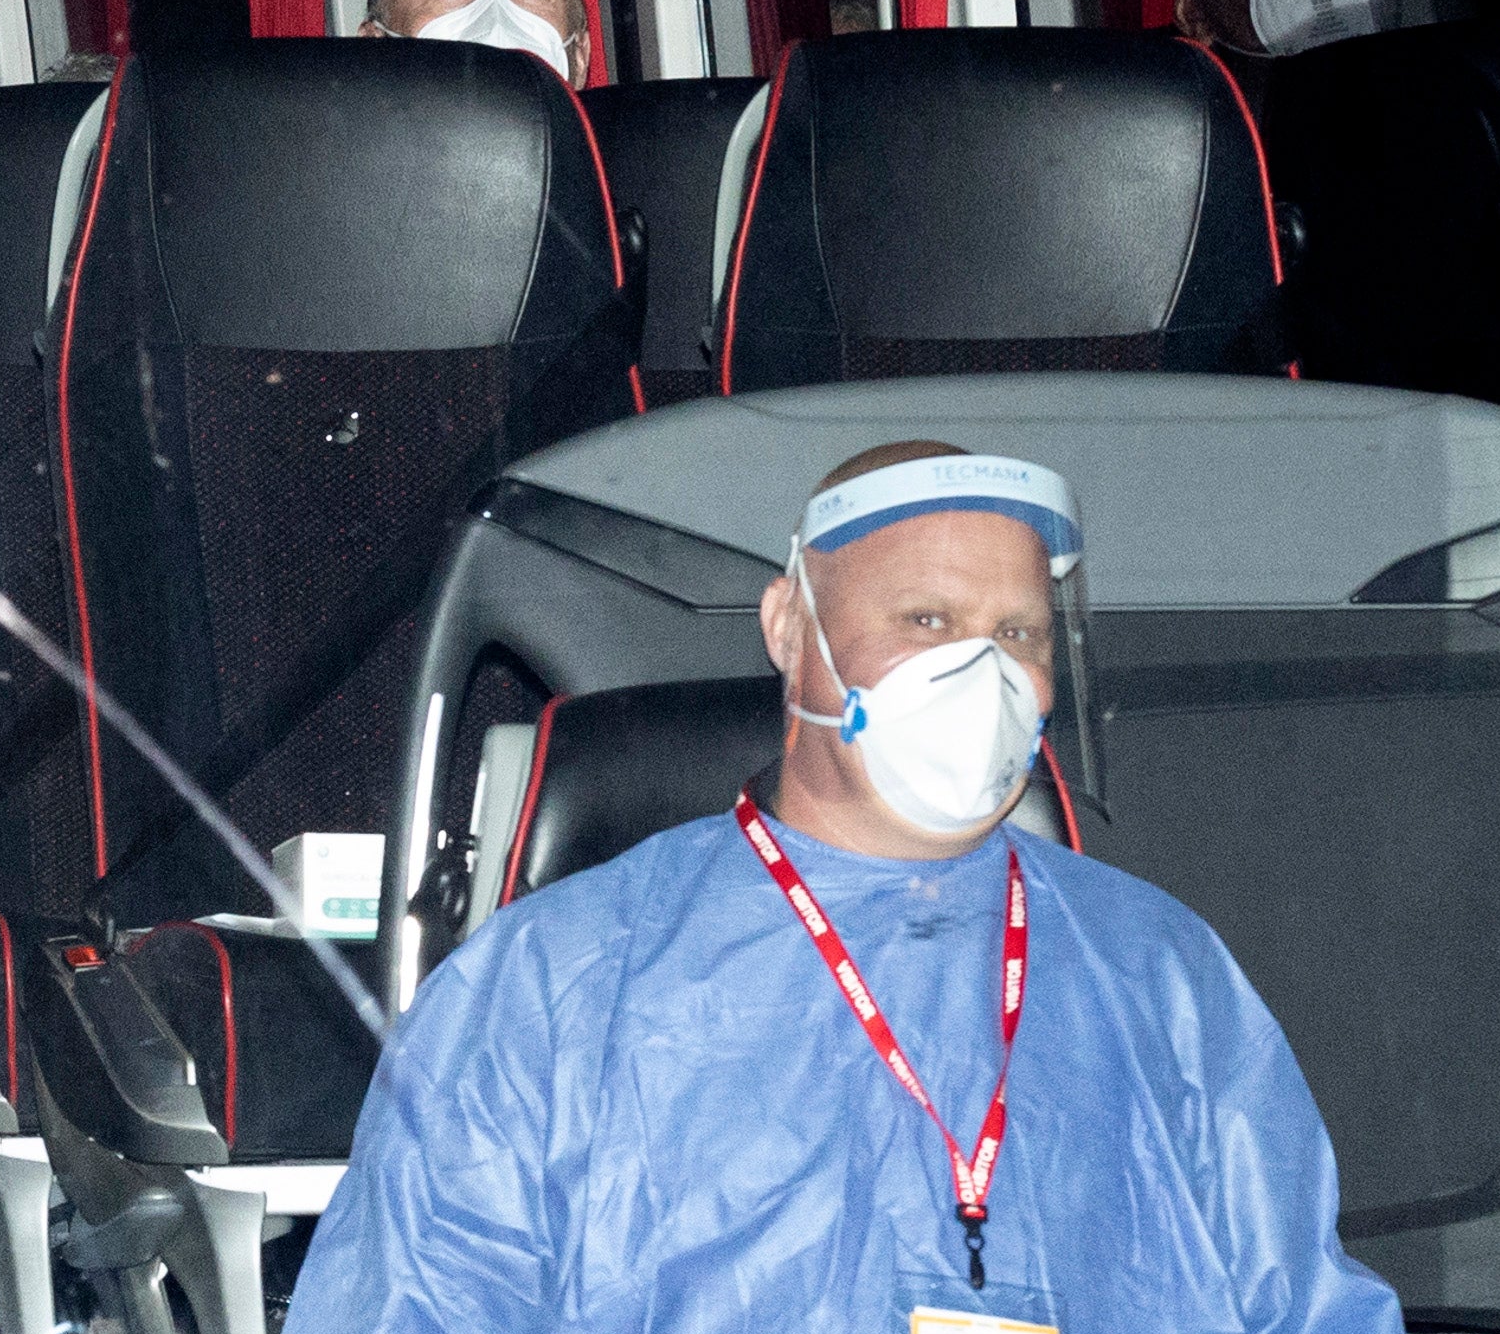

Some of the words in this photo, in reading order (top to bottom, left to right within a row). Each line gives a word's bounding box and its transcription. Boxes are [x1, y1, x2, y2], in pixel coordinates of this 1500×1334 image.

[933, 465, 1020, 482] TECMAN
[788, 883, 829, 937] VISITOR
[836, 959, 877, 1022] VISITOR
[1004, 957, 1024, 1014] VISITOR
